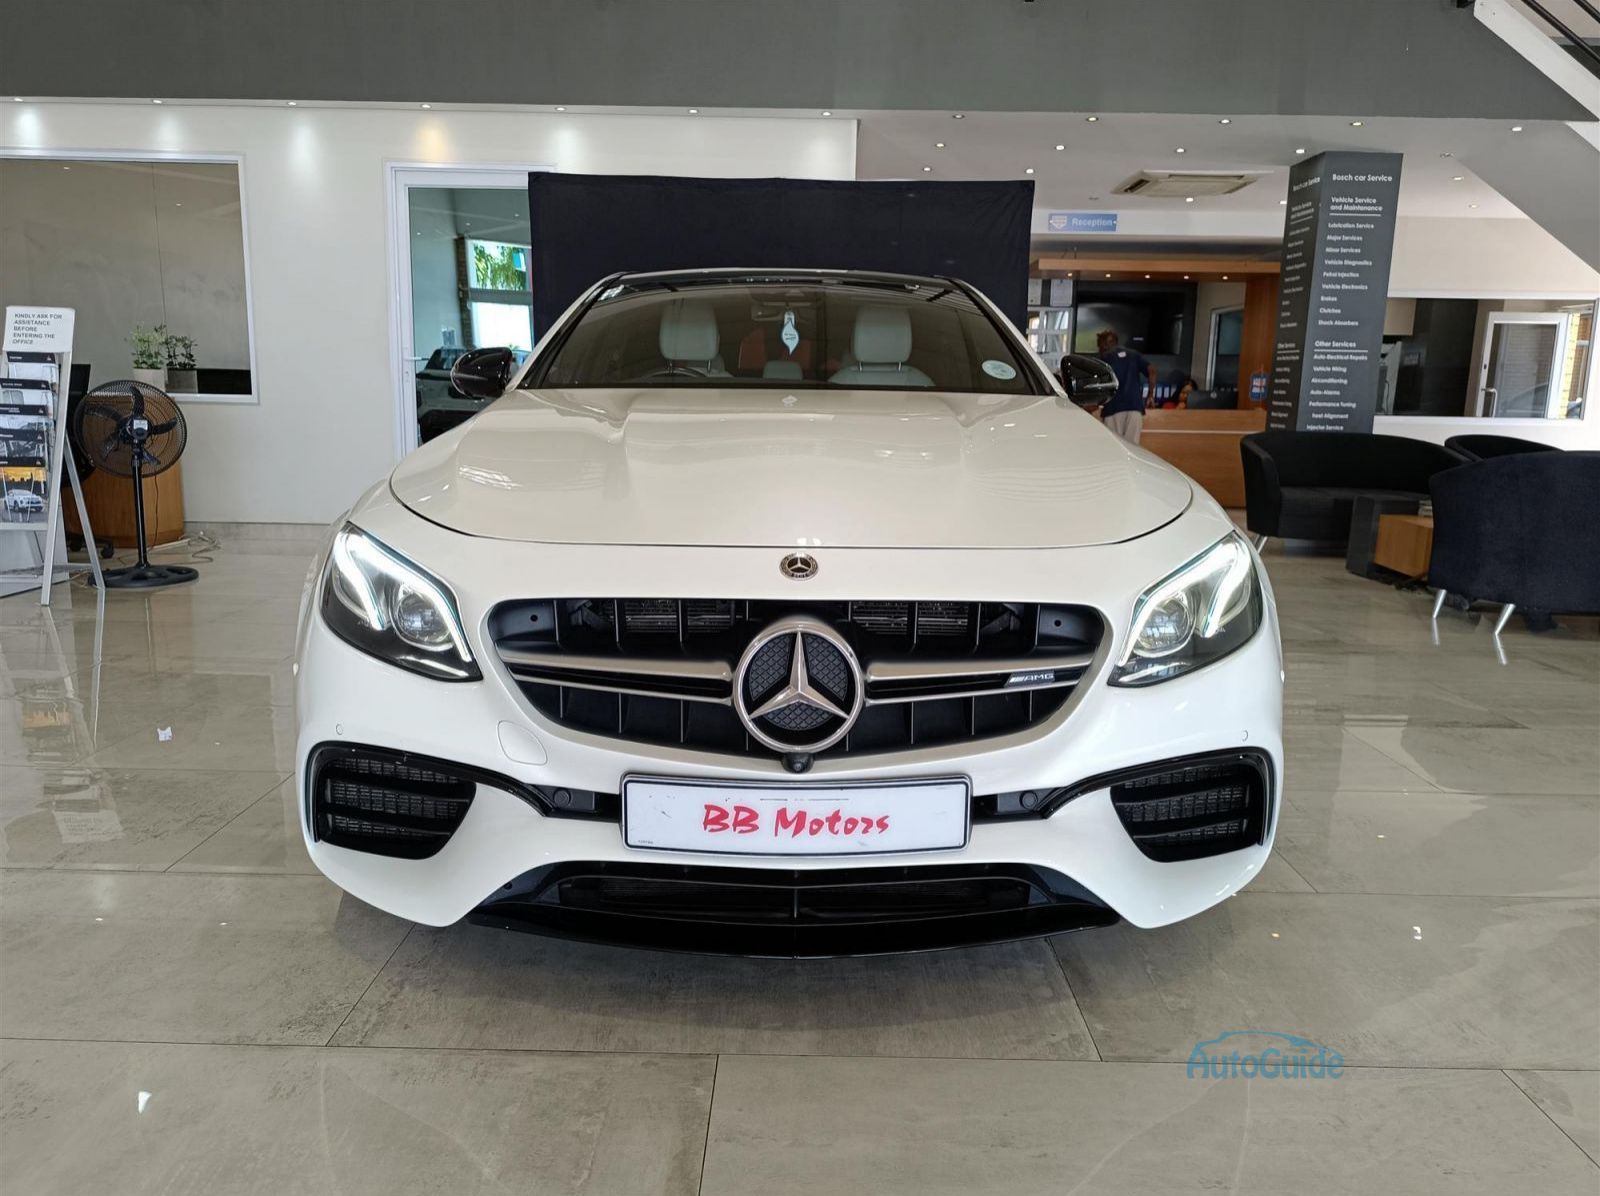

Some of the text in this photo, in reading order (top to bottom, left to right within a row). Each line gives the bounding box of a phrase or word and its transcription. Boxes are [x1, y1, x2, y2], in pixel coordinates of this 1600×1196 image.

[1333, 173, 1353, 182] Bosch
[1367, 173, 1393, 182] Service
[1331, 196, 1353, 204] Vehicle
[1071, 216, 1113, 228] Reception
[1314, 340, 1331, 348] Other
[1023, 672, 1054, 682] AMG
[703, 804, 890, 838] BB Motors
